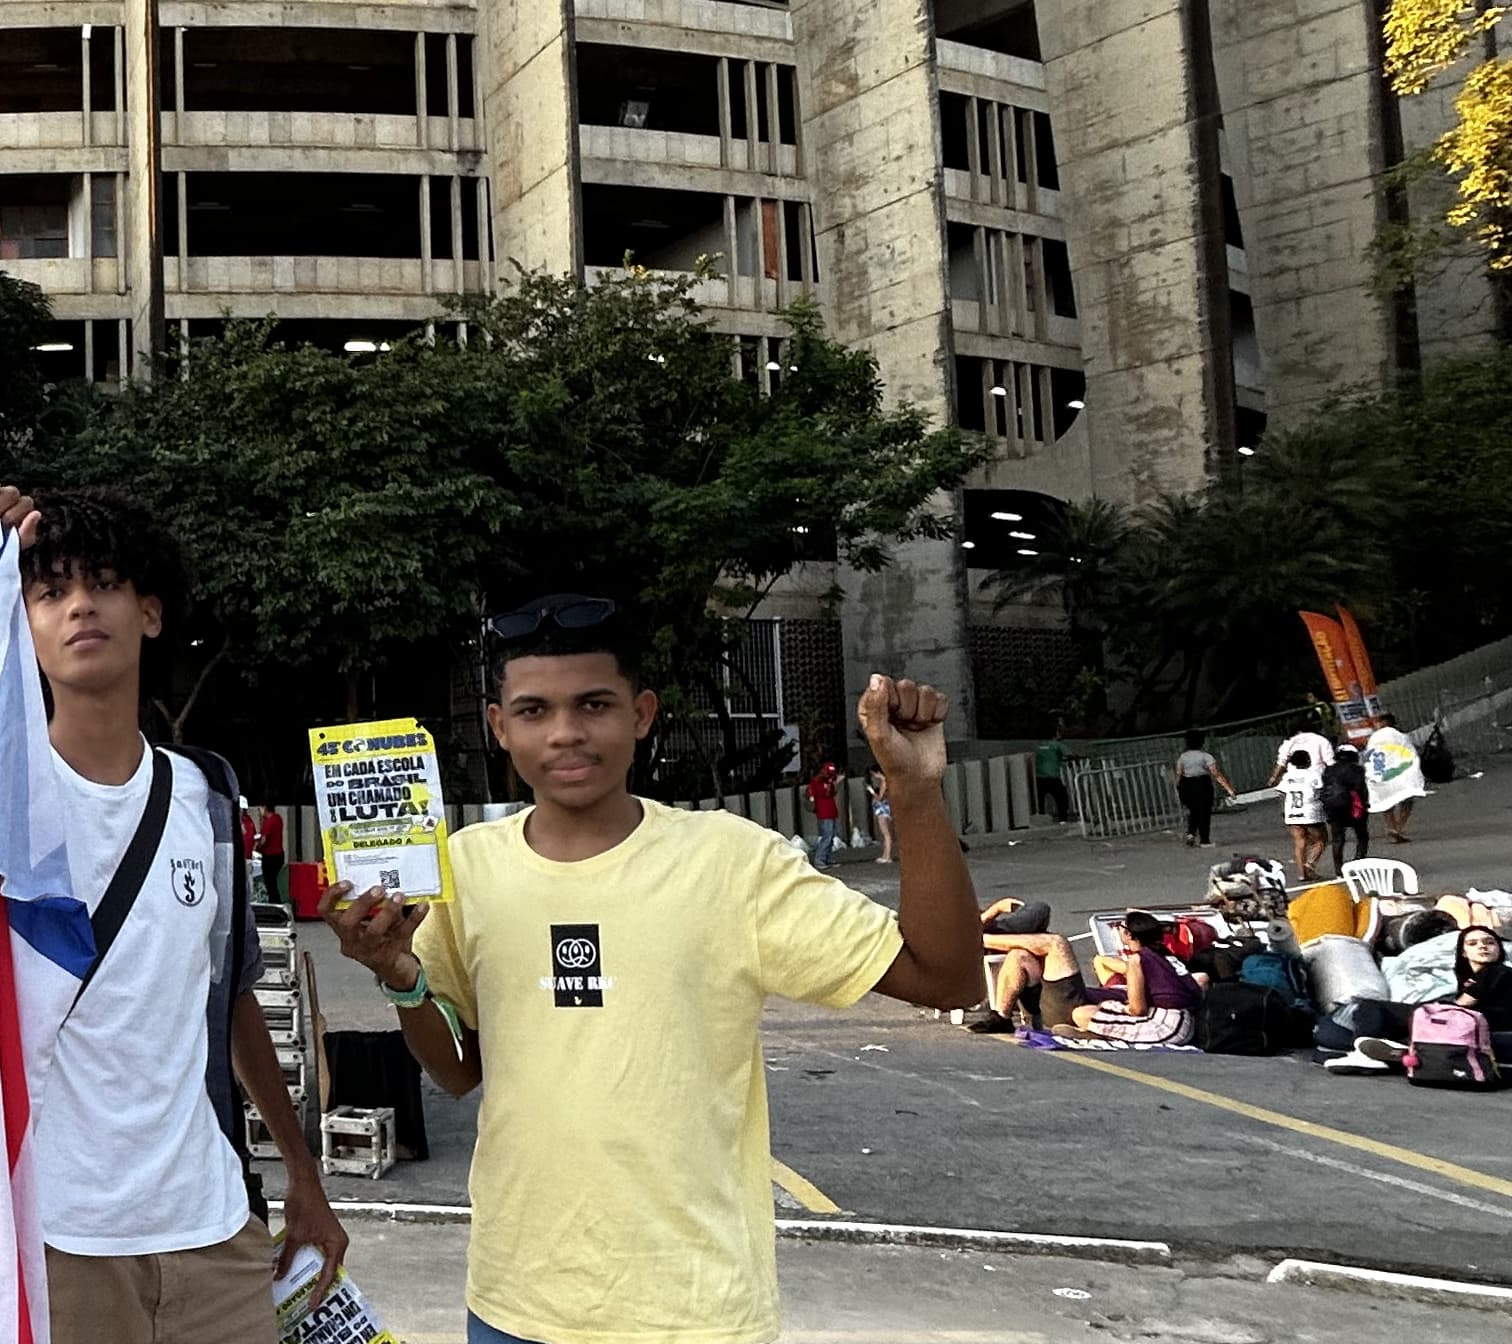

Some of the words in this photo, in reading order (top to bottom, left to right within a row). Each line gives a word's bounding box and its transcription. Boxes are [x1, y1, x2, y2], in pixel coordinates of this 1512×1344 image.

[325, 764, 342, 778] EM
[343, 760, 376, 777] CADA
[377, 756, 425, 774] ESCOLA
[326, 780, 345, 788] DO
[348, 773, 427, 789] BRASIL
[328, 792, 347, 807] UM
[348, 786, 411, 805] CHAMADO
